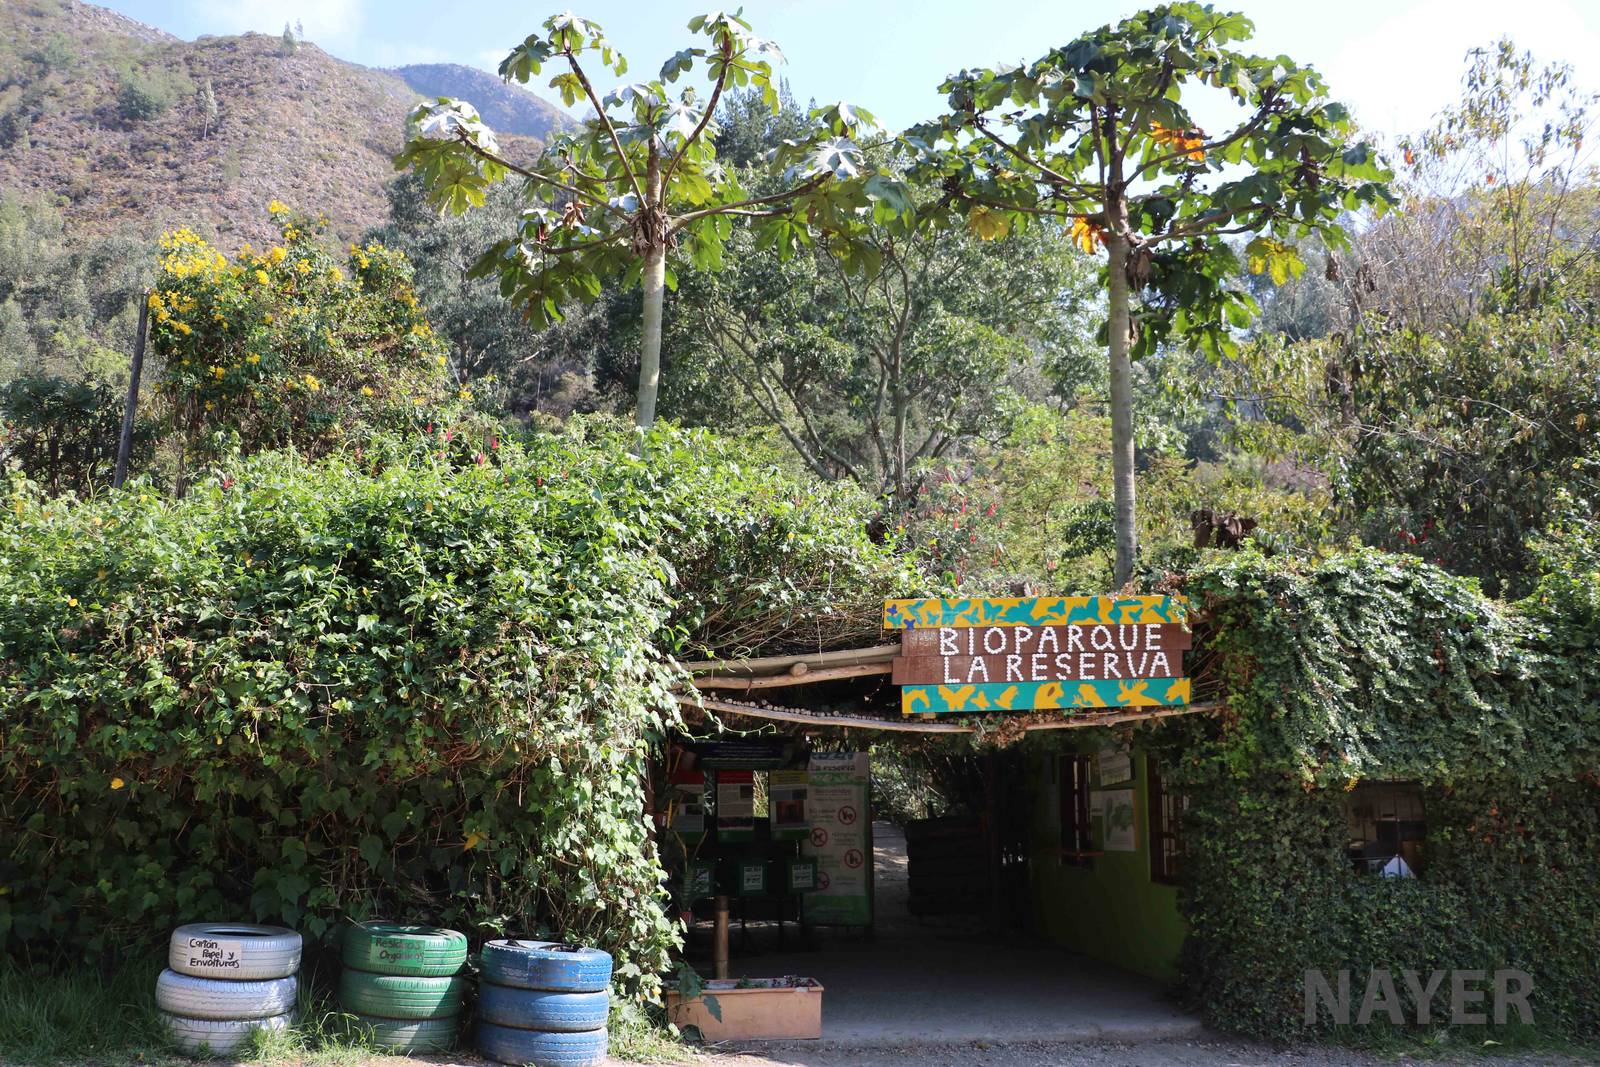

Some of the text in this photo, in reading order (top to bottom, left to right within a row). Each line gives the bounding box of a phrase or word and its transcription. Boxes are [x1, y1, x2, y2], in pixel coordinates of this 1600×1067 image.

[939, 624, 1162, 656] BIOPARQUE
[943, 651, 1171, 684] LA RESERVA
[190, 958, 240, 968] Envolturas
[202, 949, 235, 960] Papel y
